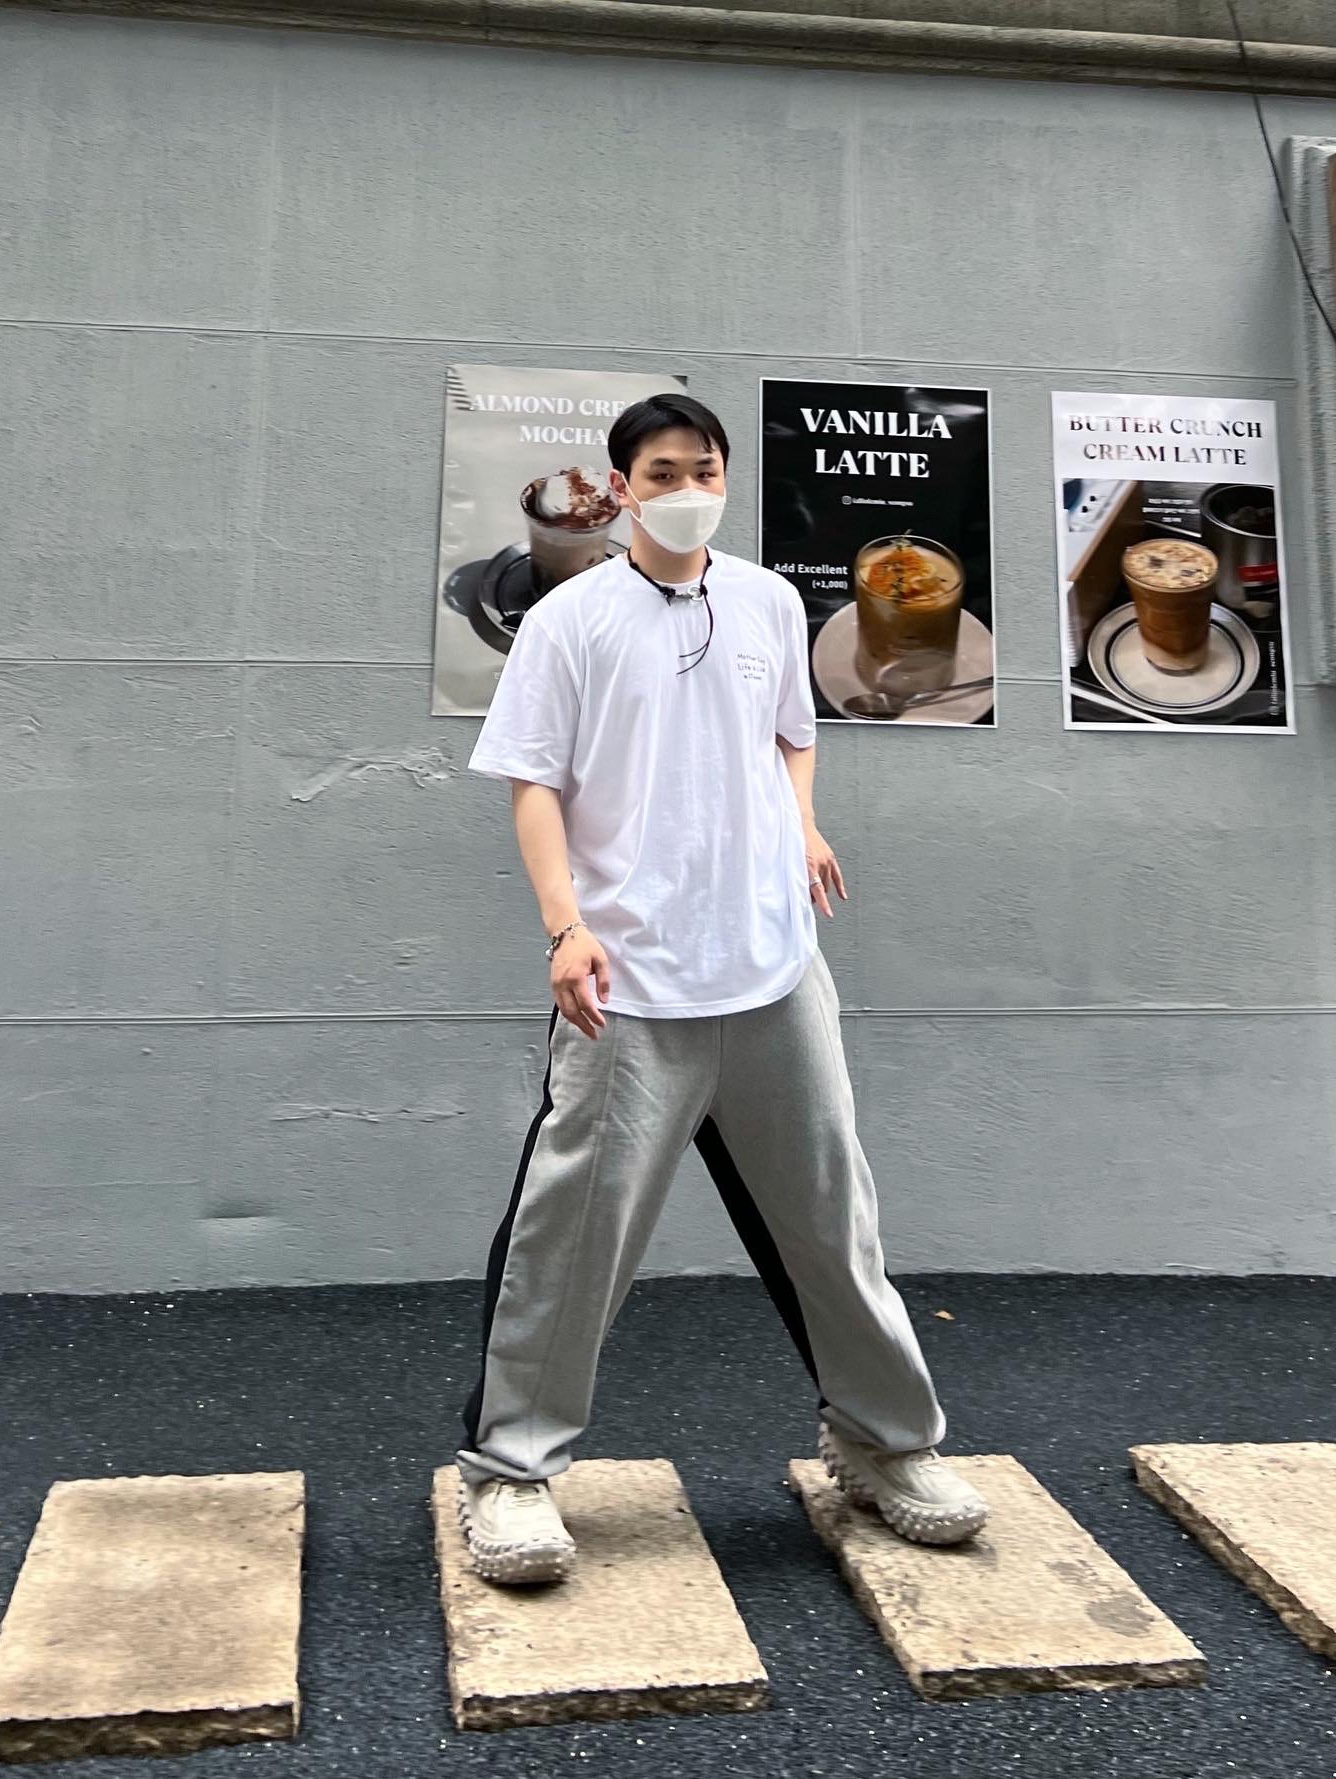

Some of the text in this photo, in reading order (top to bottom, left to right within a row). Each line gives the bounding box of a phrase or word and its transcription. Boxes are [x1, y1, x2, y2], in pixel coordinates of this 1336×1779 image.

[469, 393, 643, 418] ALMOND CRE
[799, 407, 953, 439] VANILLA
[1069, 414, 1262, 438] BUTTER CRUNCH
[518, 424, 608, 446] MOCHA
[815, 448, 930, 478] LATTE
[1083, 443, 1247, 465] CREAM LATTE
[774, 563, 848, 575] Add Excellent
[811, 579, 848, 590] (+1,000)
